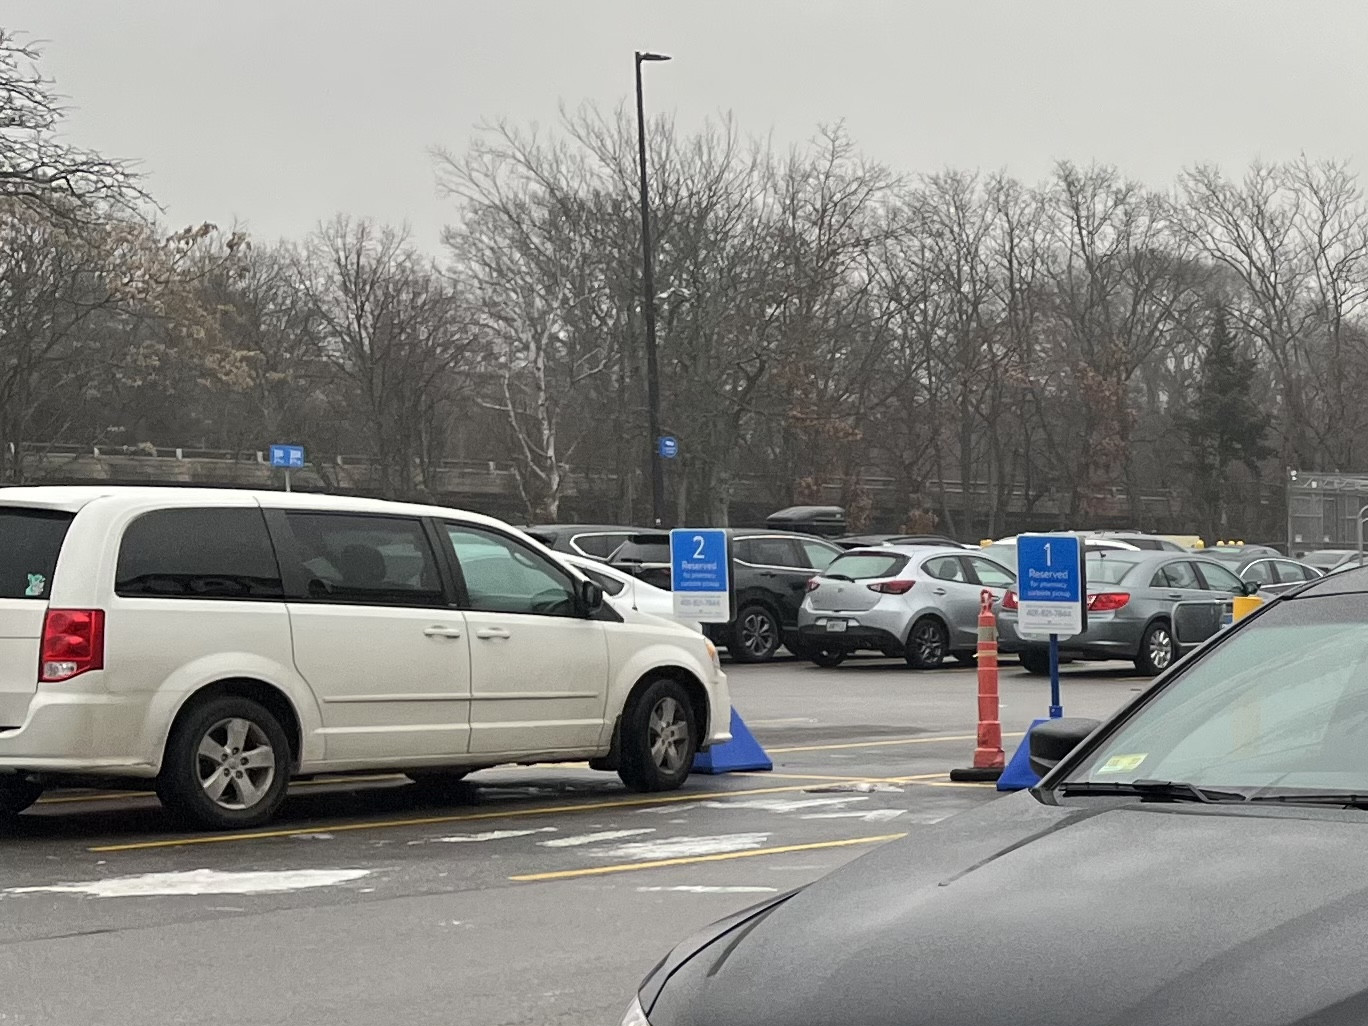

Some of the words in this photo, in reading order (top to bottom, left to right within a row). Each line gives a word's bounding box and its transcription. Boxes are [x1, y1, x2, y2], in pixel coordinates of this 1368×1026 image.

[692, 535, 705, 559] 2
[1043, 542, 1052, 567] 1
[681, 560, 717, 571] Reserved
[1028, 568, 1069, 580] Reserved
